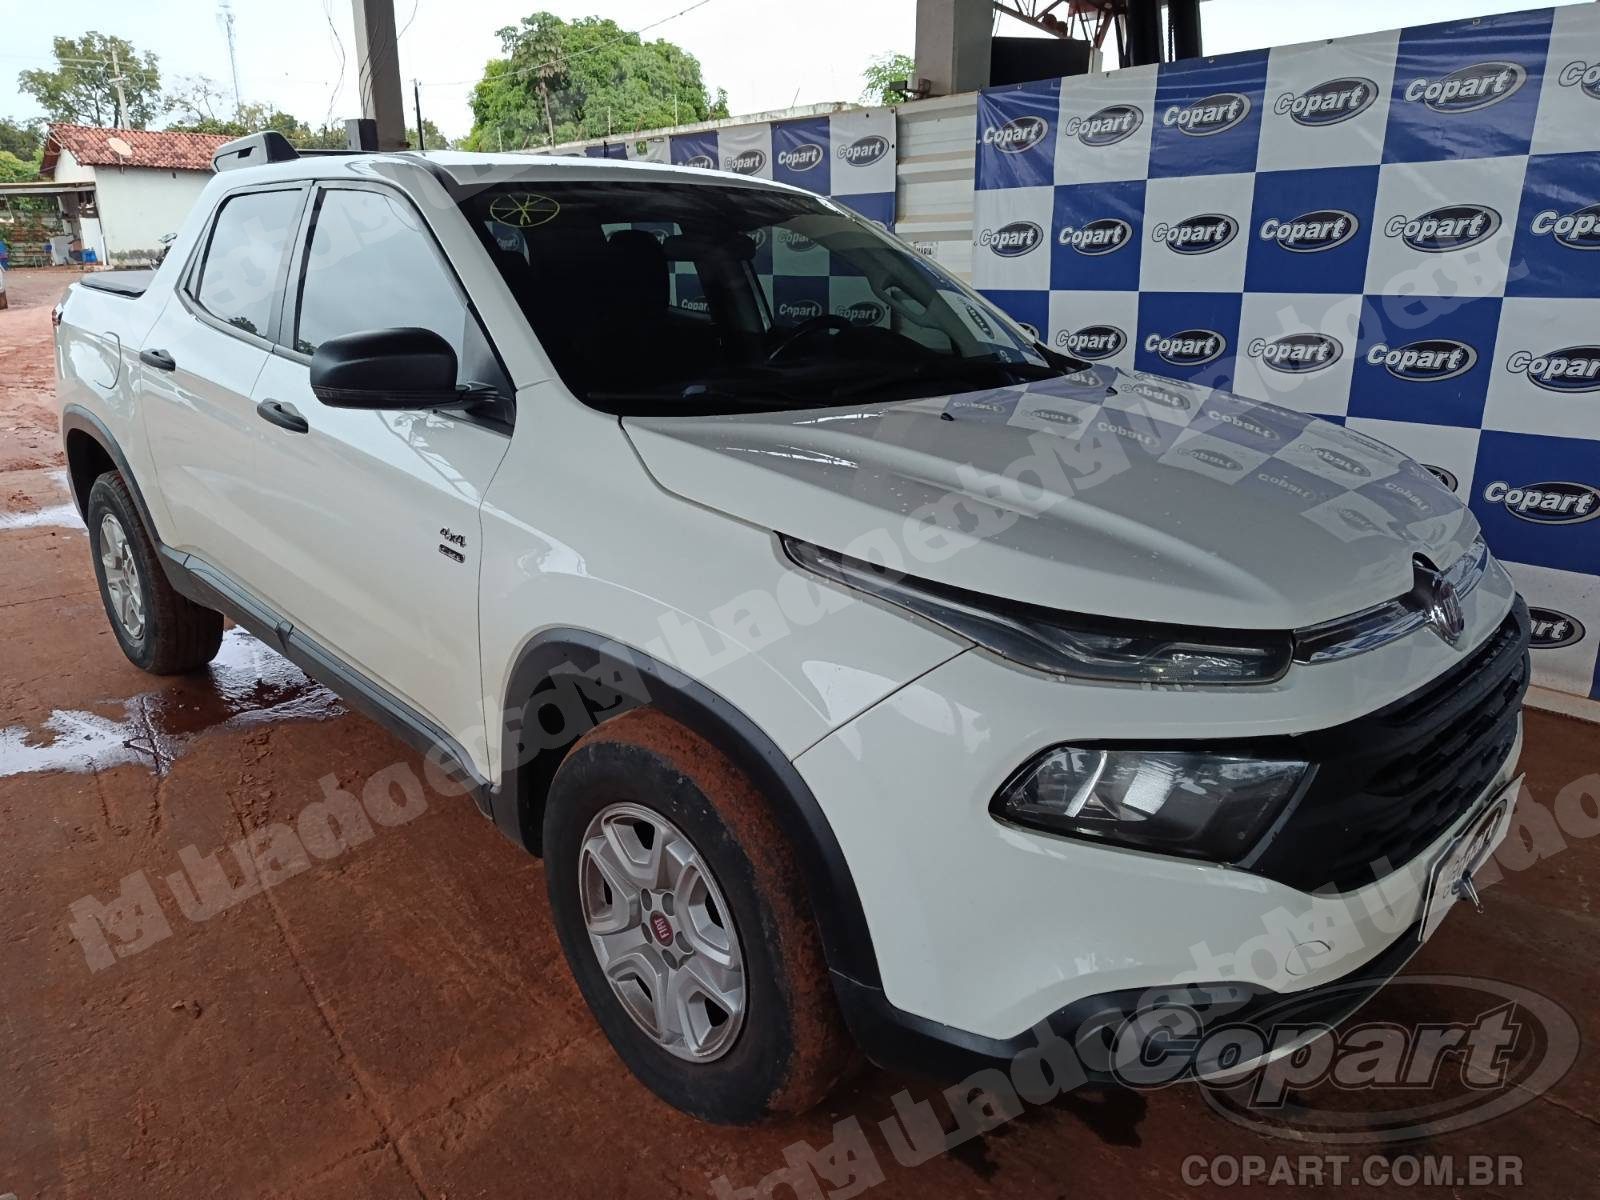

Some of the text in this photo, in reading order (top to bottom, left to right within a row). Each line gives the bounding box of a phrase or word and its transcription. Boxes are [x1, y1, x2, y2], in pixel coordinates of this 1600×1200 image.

[1405, 66, 1513, 105] Copart
[1274, 81, 1364, 117] Copart
[1065, 111, 1134, 138] Copart
[1163, 98, 1240, 129] Copart
[983, 124, 1041, 148] Copart
[724, 154, 760, 170] Copart
[778, 149, 818, 166] Copart
[837, 143, 881, 161] Copart
[979, 226, 1036, 248] Copart
[1059, 223, 1124, 248] Copart
[1152, 218, 1228, 246] Copart
[1259, 214, 1347, 244] Copart
[1384, 210, 1488, 243] Copart
[1530, 209, 1600, 240] Cop
[681, 299, 709, 312] Copar
[779, 303, 818, 318] Copart
[1055, 328, 1118, 352] Copart
[1144, 333, 1217, 355] Copart
[1248, 337, 1330, 362] Copart
[1367, 342, 1463, 372] Copart
[1506, 350, 1600, 381] Copar
[1483, 480, 1595, 514] Copart
[654, 917, 670, 939] FIAT
